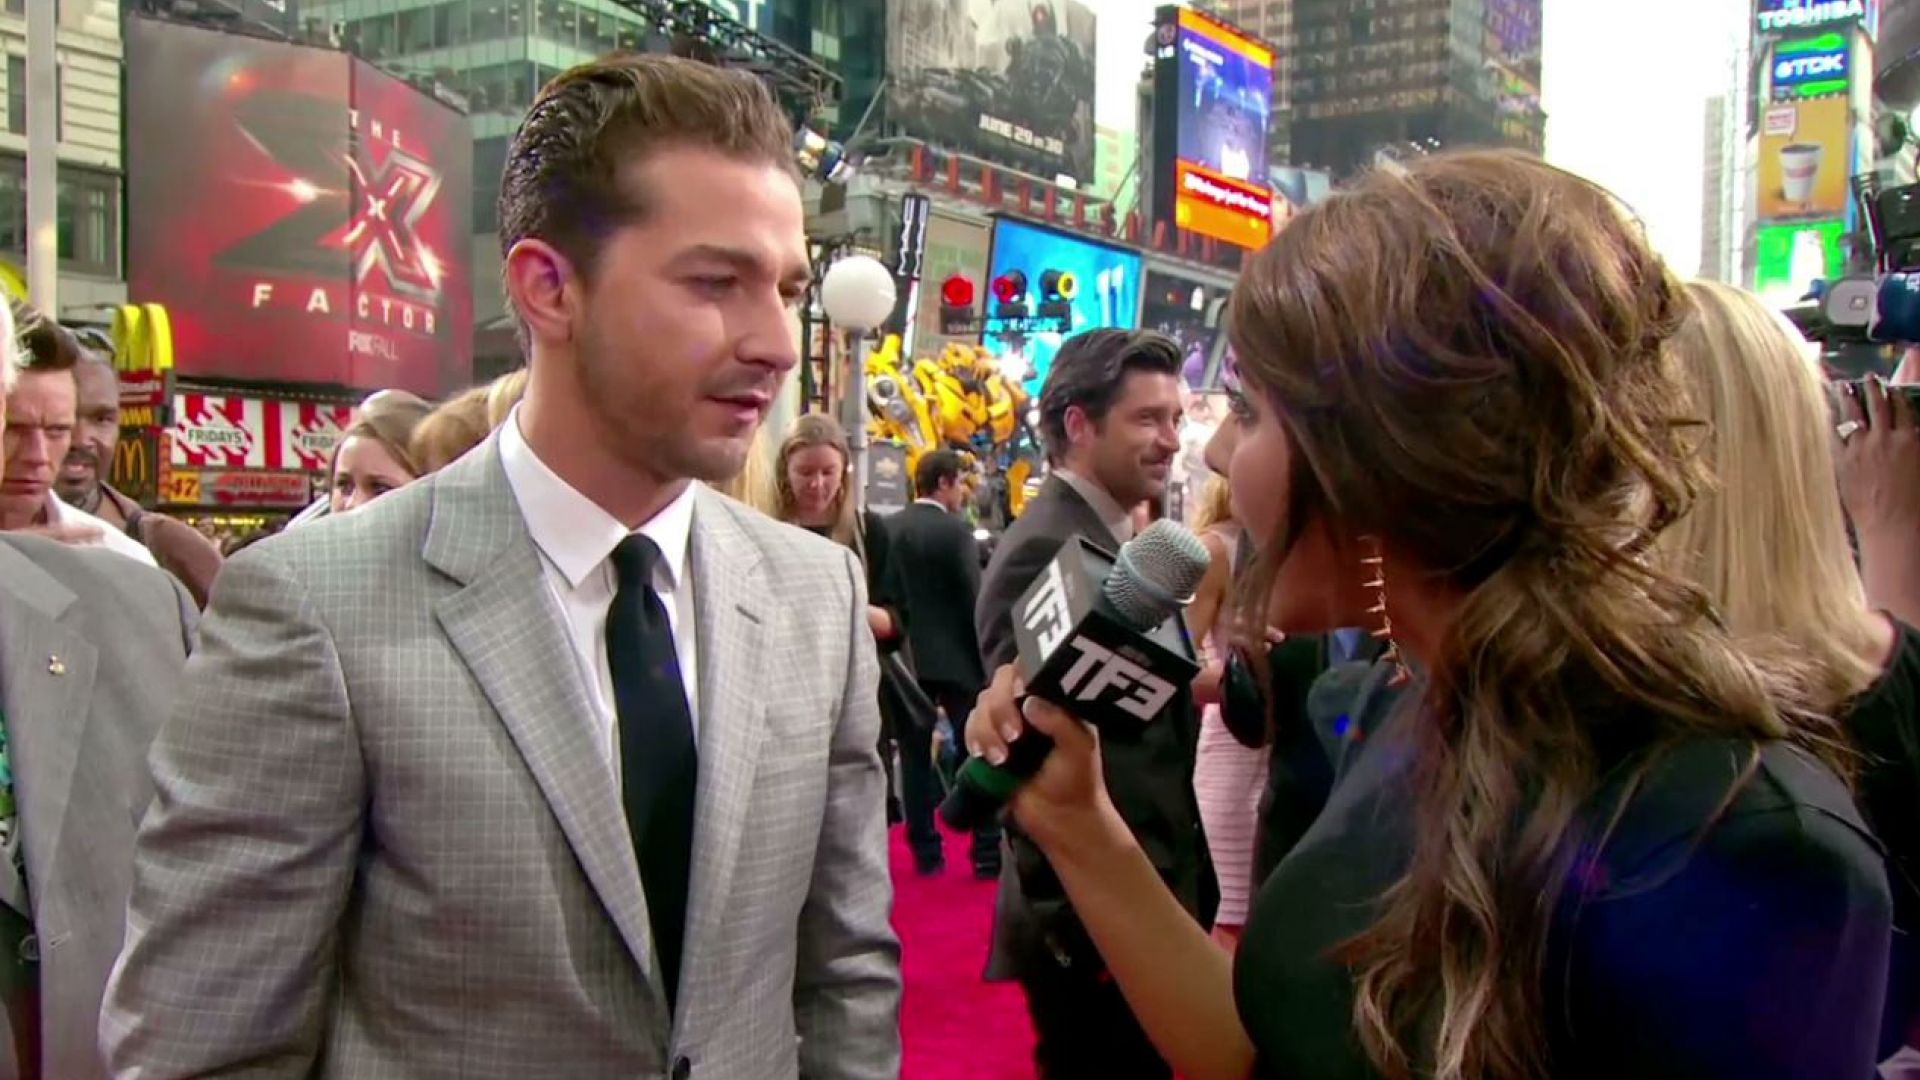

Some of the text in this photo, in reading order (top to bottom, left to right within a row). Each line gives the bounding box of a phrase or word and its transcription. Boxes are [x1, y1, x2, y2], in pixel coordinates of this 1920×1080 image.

[1758, 0, 1864, 31] TOSHIBA
[1792, 53, 1844, 76] TDK
[349, 109, 402, 149] THE
[979, 112, 1013, 140] JUNE
[252, 283, 436, 334] FACTOR
[1023, 557, 1073, 662] TF3
[1060, 633, 1178, 722] TF3
